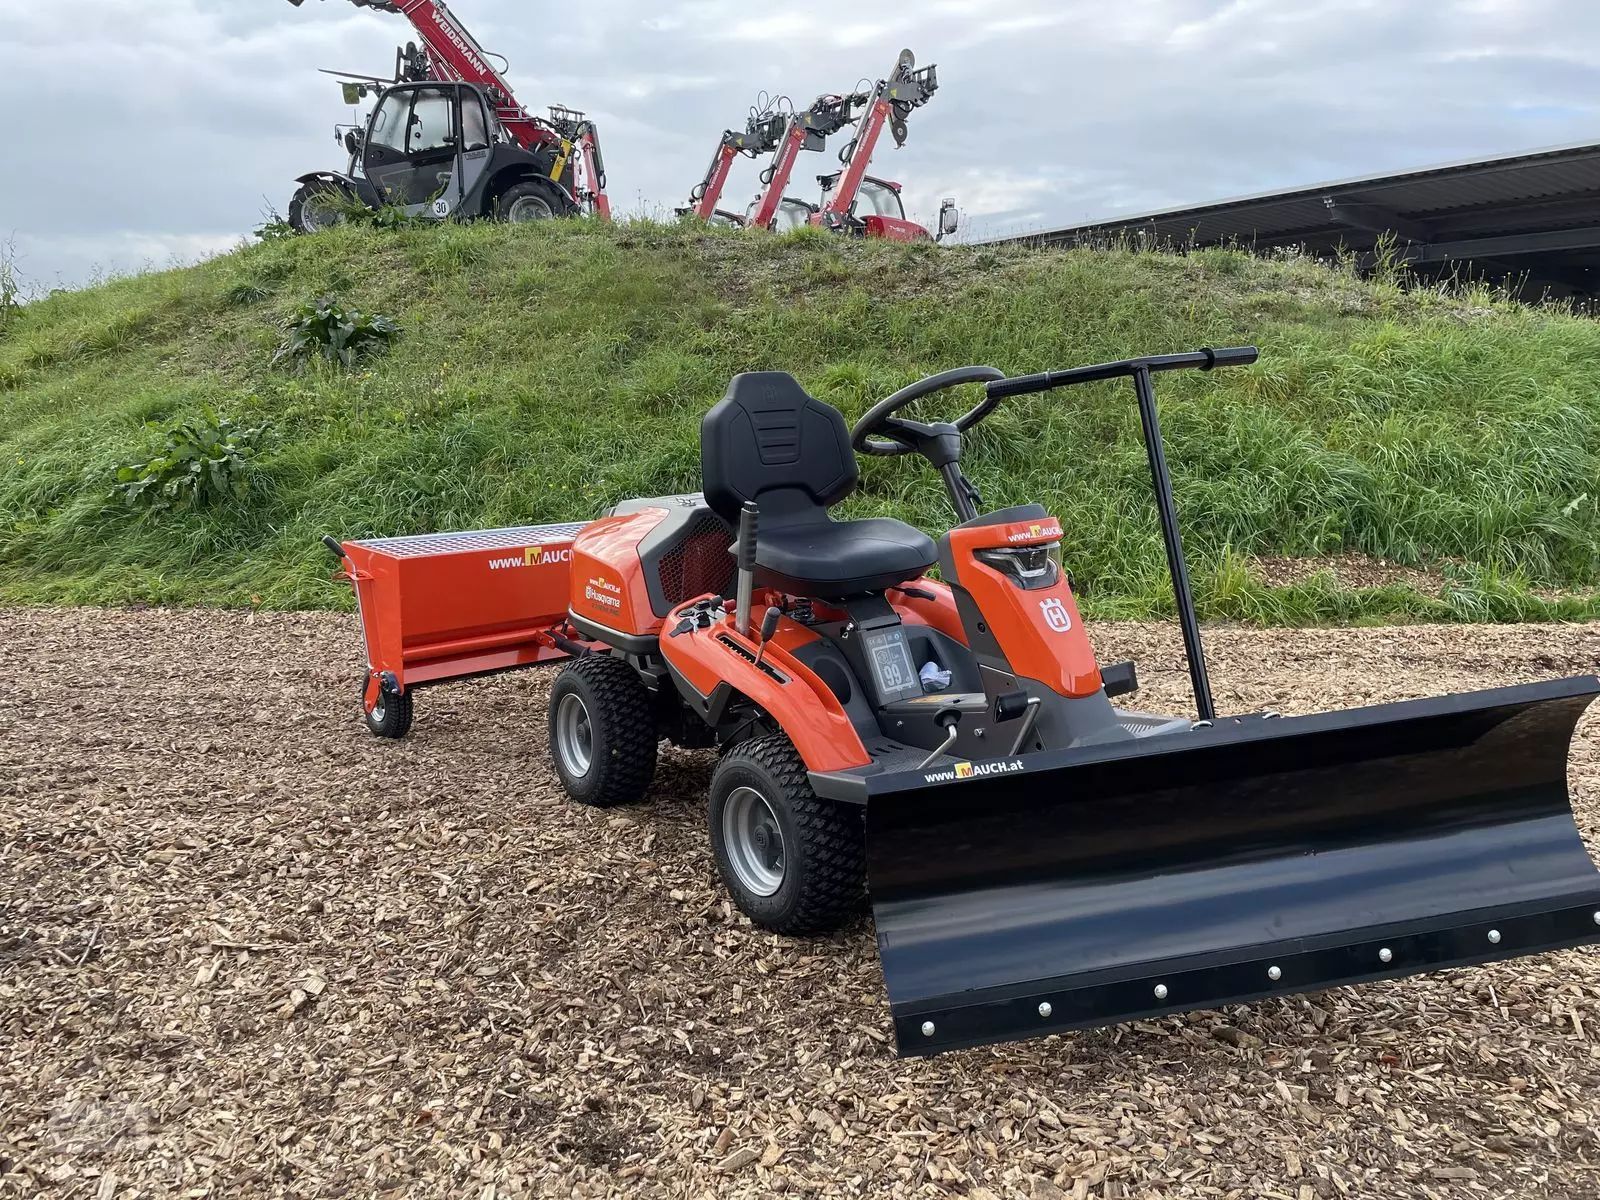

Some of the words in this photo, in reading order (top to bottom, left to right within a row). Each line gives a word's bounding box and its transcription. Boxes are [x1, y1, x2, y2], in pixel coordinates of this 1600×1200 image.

[431, 9, 487, 76] WEIDEMANN
[436, 202, 447, 214] 30
[591, 587, 620, 608] Husqvarna
[884, 663, 902, 686] 99
[925, 760, 1024, 783] www.MAUCH.at
